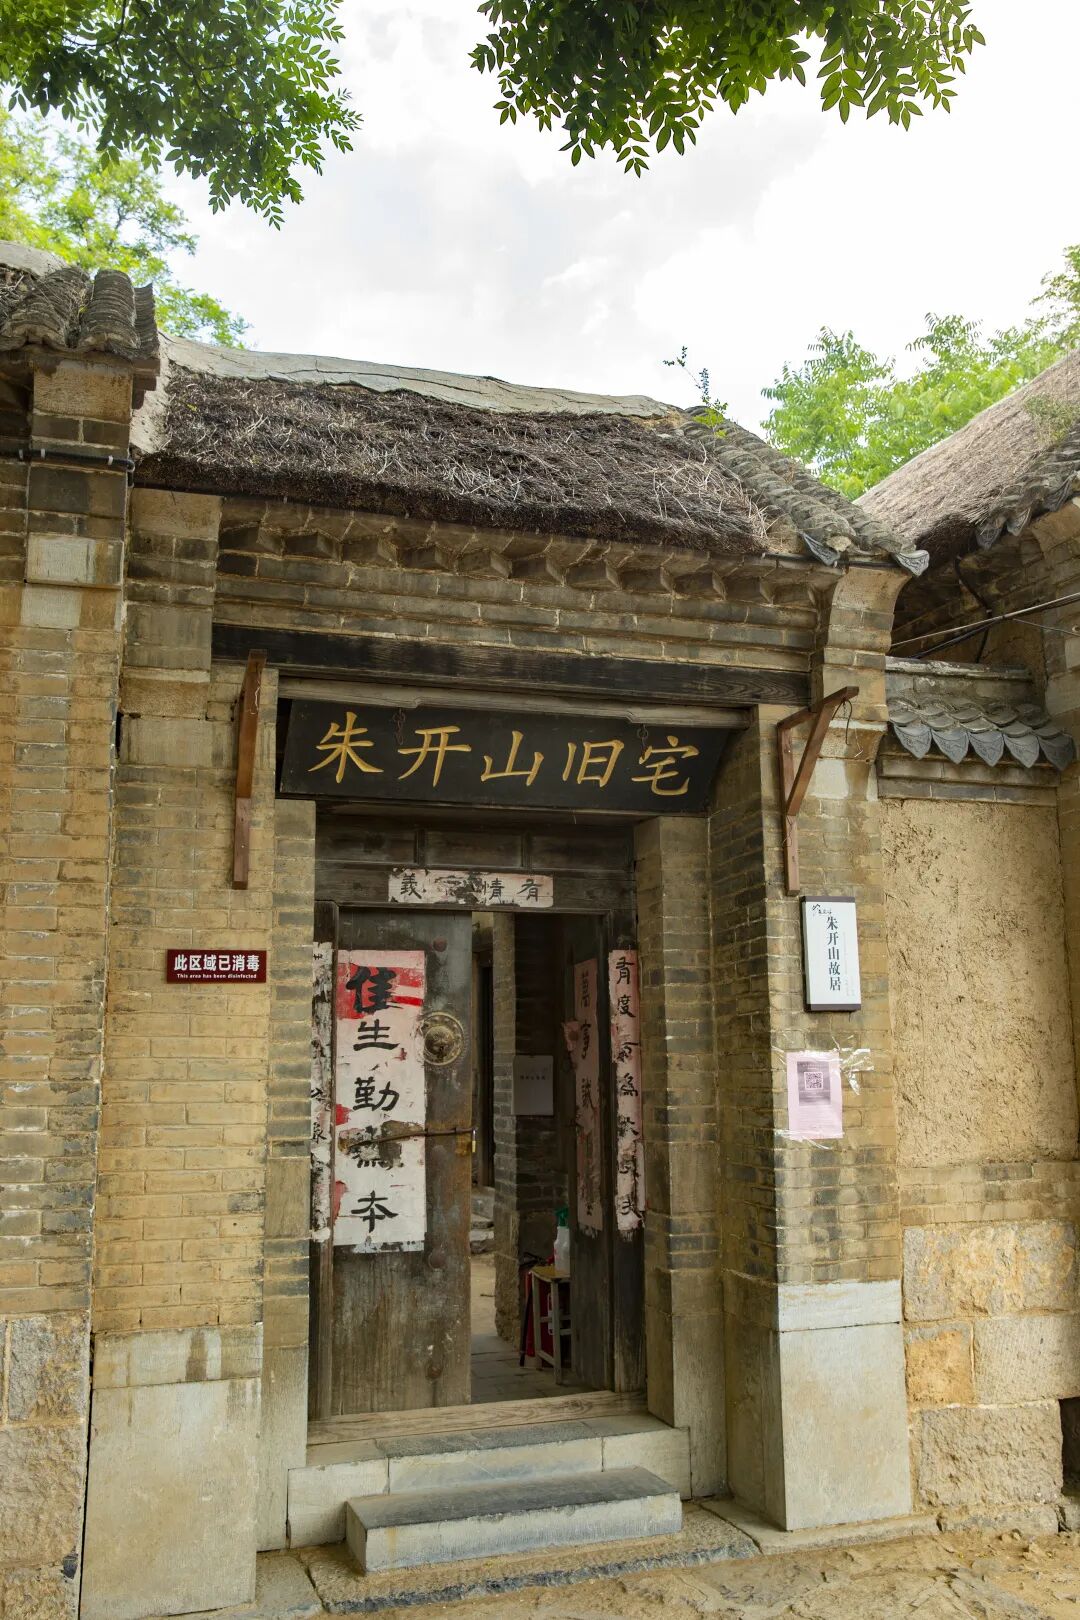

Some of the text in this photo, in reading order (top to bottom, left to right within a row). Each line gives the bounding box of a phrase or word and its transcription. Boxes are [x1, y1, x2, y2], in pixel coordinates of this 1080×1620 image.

[307, 711, 700, 796] 朱开山旧宅
[174, 954, 260, 972] 此区域已消毒
[826, 916, 842, 992] 朱开山故居
